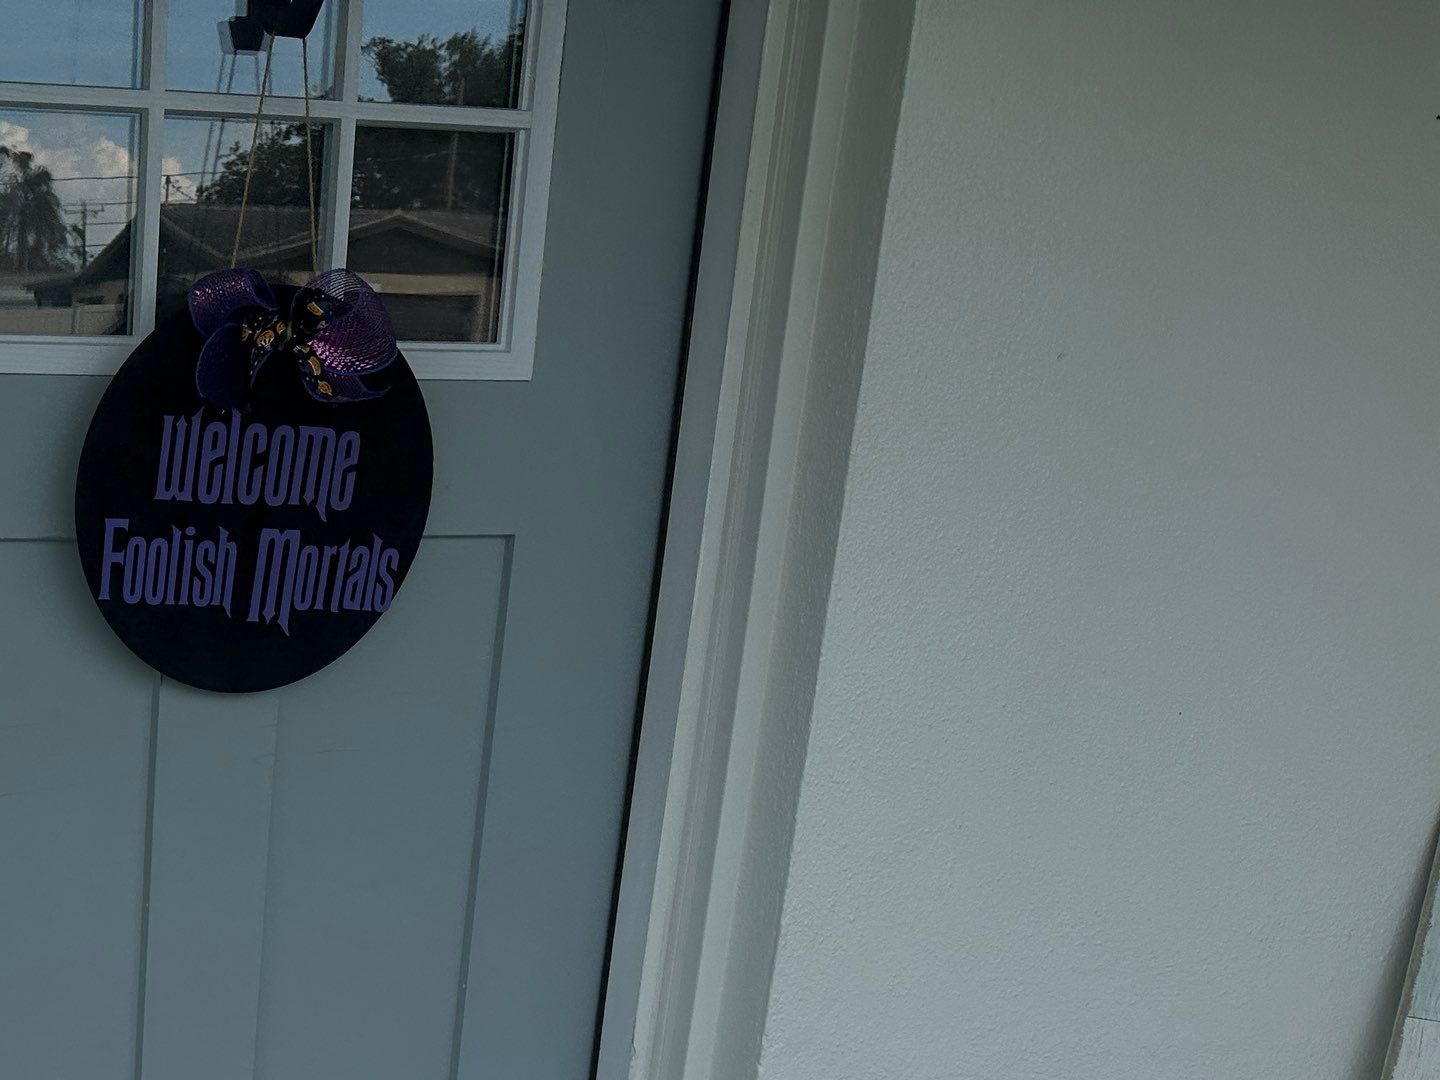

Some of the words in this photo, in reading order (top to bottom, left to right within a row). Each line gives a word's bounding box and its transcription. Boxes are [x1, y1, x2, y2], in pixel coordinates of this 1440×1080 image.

[153, 406, 361, 522] Welcome
[98, 517, 238, 619] Foolish
[246, 527, 400, 636] Mortals
